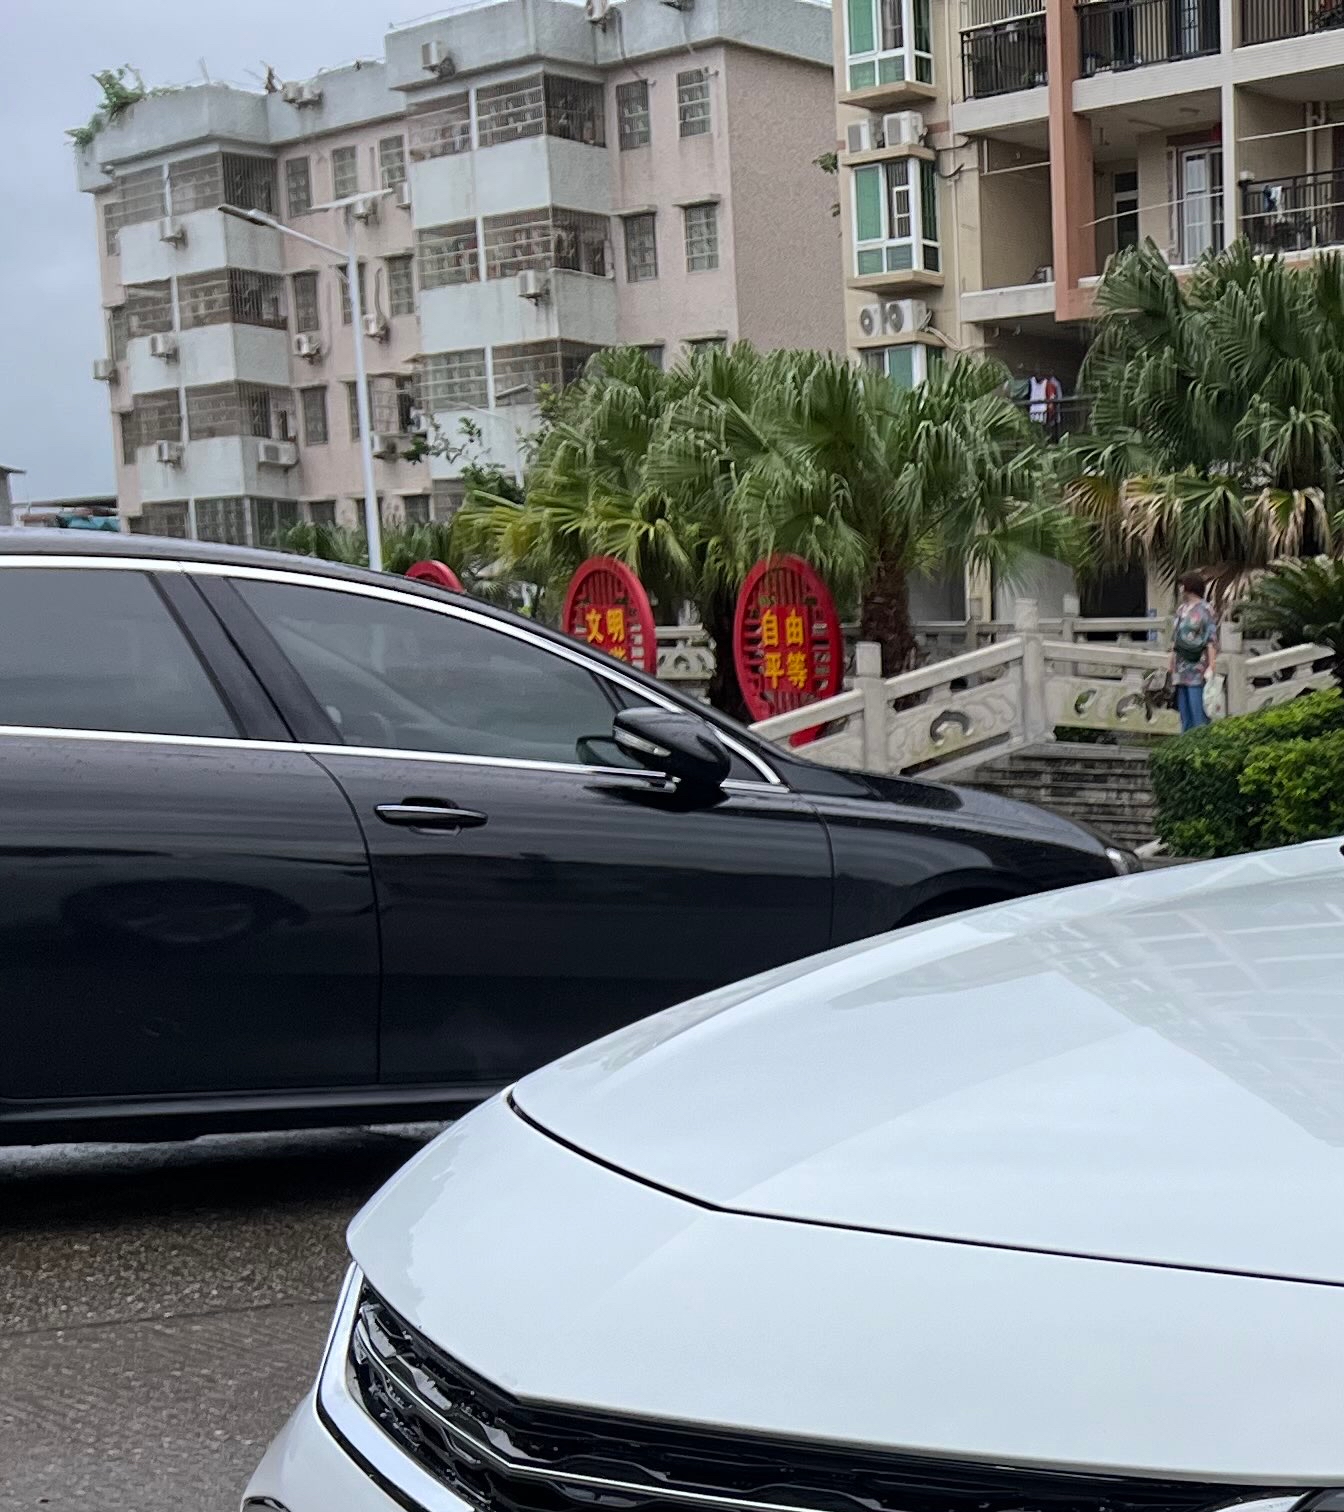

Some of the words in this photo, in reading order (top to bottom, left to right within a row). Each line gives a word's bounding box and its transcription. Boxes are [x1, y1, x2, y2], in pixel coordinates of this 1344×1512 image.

[585, 608, 625, 643] 文明
[762, 608, 804, 647] 自由
[763, 651, 808, 689] 平等
